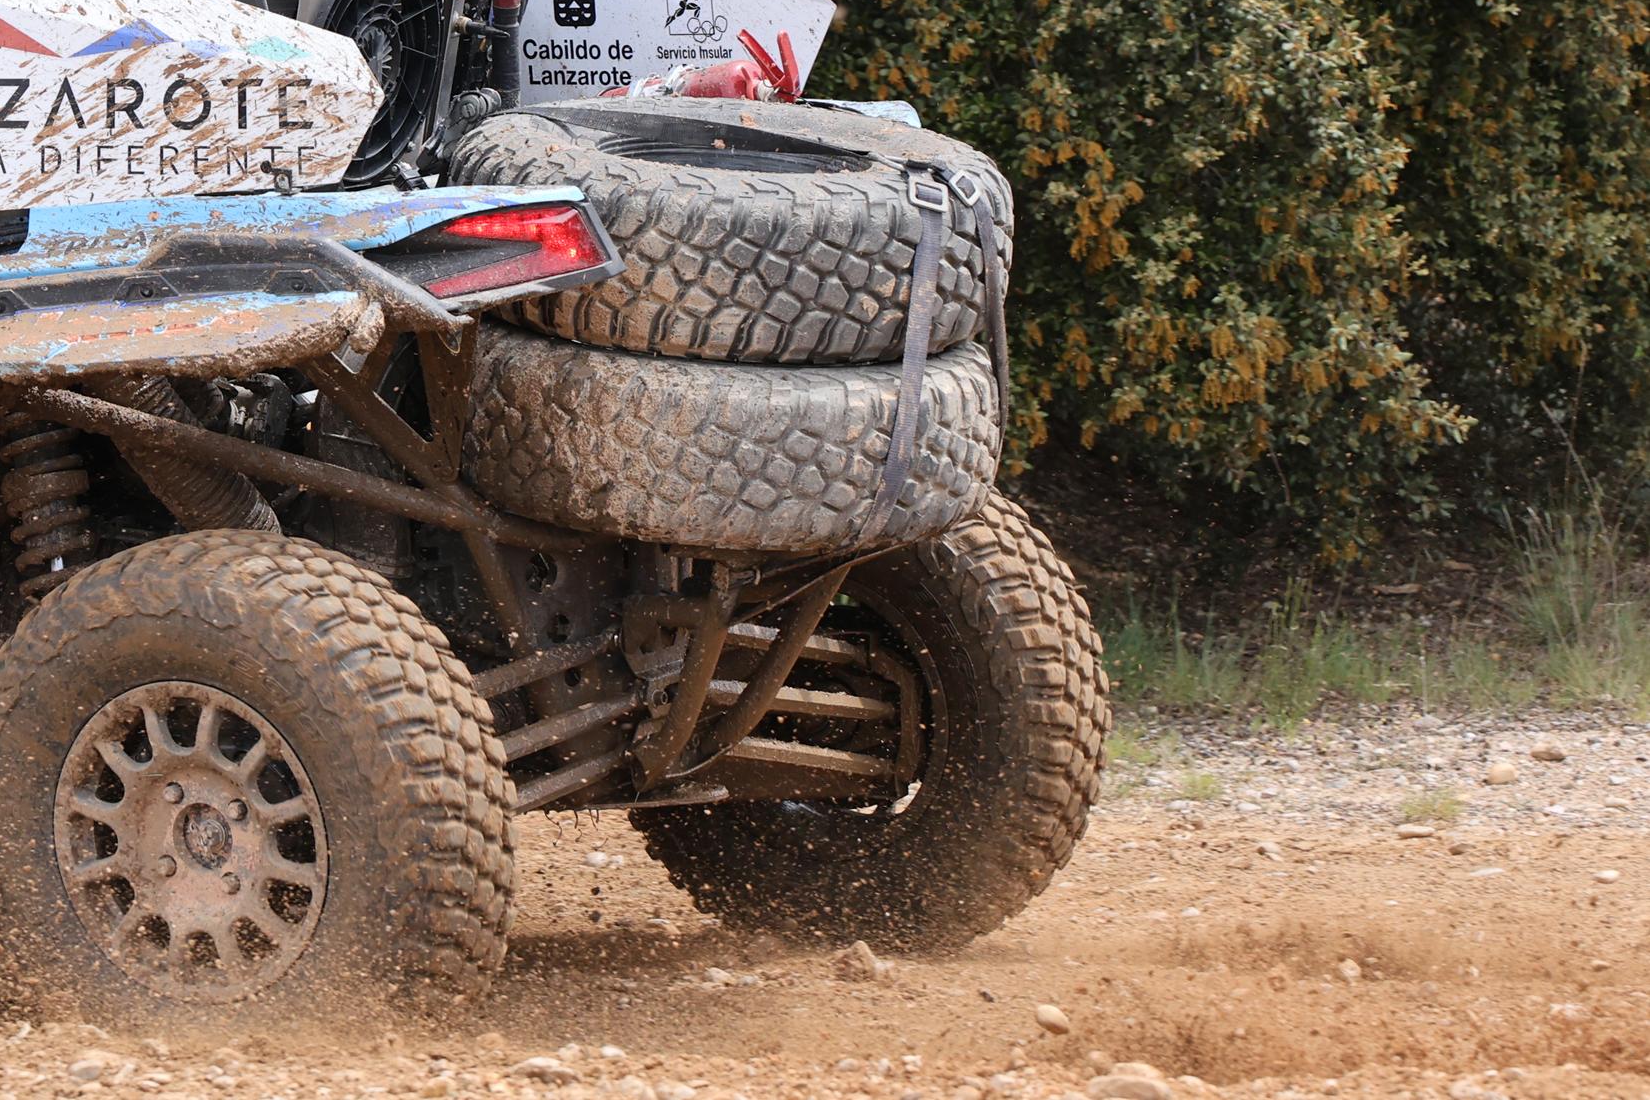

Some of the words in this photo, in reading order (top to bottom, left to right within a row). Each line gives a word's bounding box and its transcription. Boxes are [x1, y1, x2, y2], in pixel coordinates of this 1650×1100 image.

[522, 39, 601, 60] Cabildo
[608, 39, 634, 60] de
[657, 45, 697, 60] Servicio
[699, 45, 733, 60] Insular
[528, 65, 632, 86] Lanzarote
[40, 145, 316, 176] DIFERENTE
